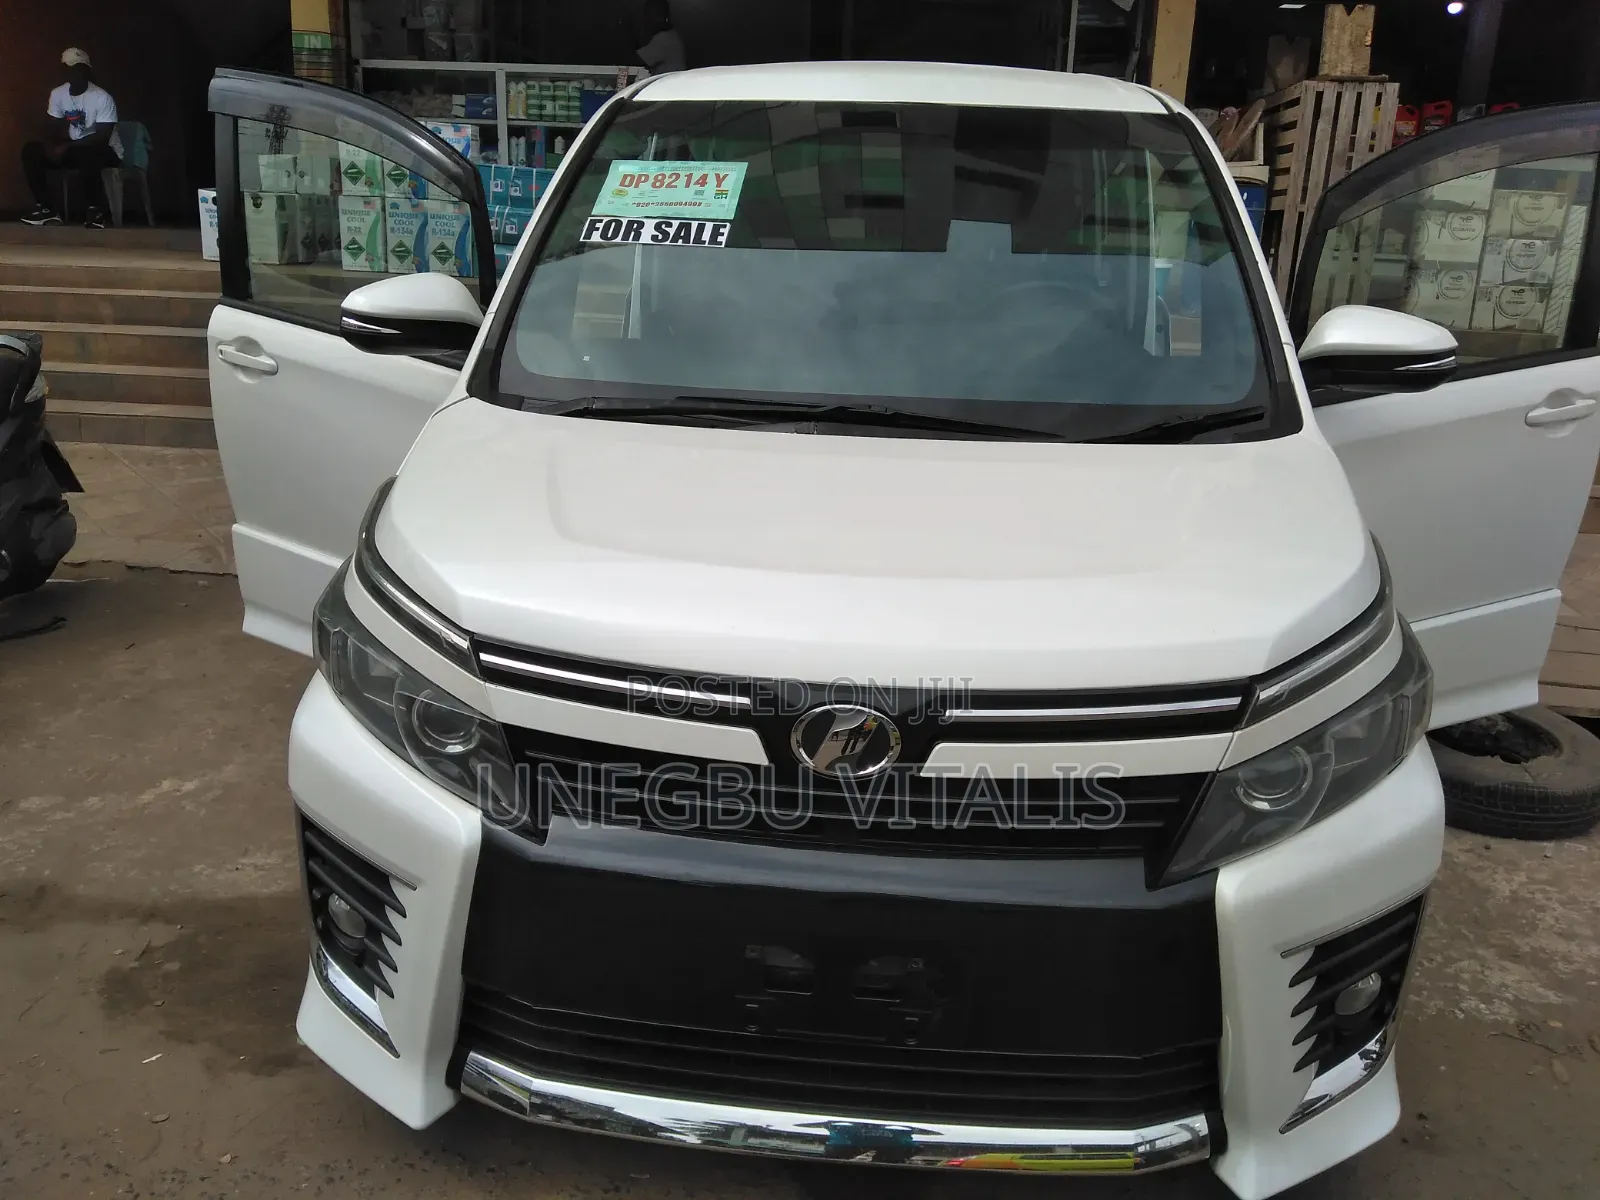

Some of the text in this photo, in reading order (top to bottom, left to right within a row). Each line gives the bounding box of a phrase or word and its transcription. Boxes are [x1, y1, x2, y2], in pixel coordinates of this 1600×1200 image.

[618, 172, 730, 188] DP 8214 Y
[341, 208, 370, 217] UNIQUE
[430, 213, 460, 221] UNIQUE
[394, 219, 415, 227] COOL
[435, 220, 456, 228] COOL
[346, 226, 362, 234] R-22
[431, 229, 455, 237] R-134a
[582, 218, 730, 246] FOR SALE
